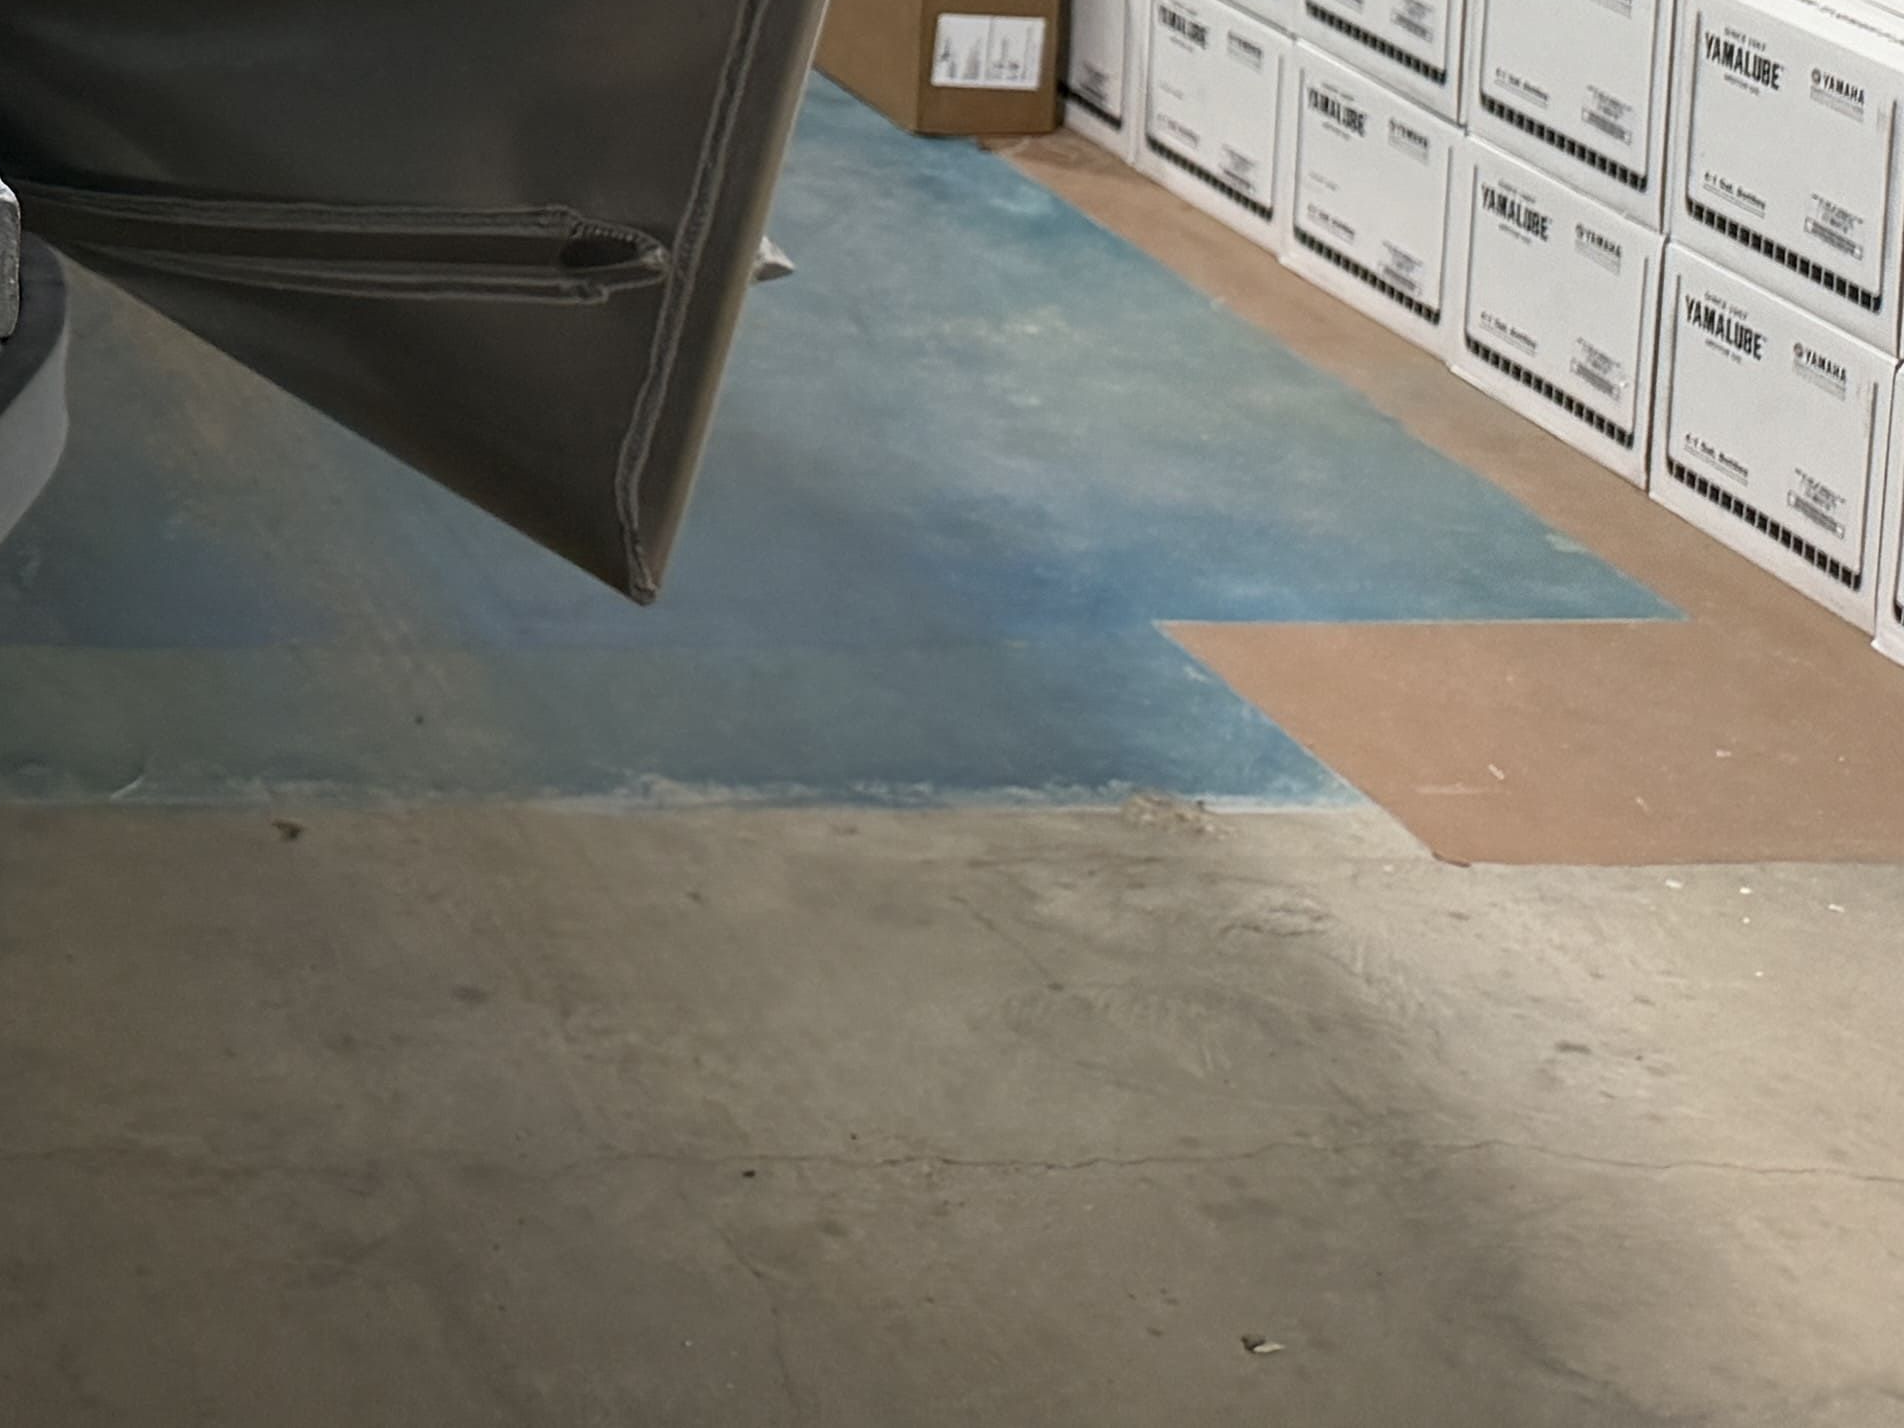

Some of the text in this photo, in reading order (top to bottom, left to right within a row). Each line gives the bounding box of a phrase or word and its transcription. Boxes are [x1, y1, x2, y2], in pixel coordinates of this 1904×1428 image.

[1704, 31, 1780, 91] YAMALUBE
[1823, 71, 1865, 105] YAMAHA
[1685, 294, 1766, 361] YAMALUBE
[1805, 349, 1847, 382] YAMAHA
